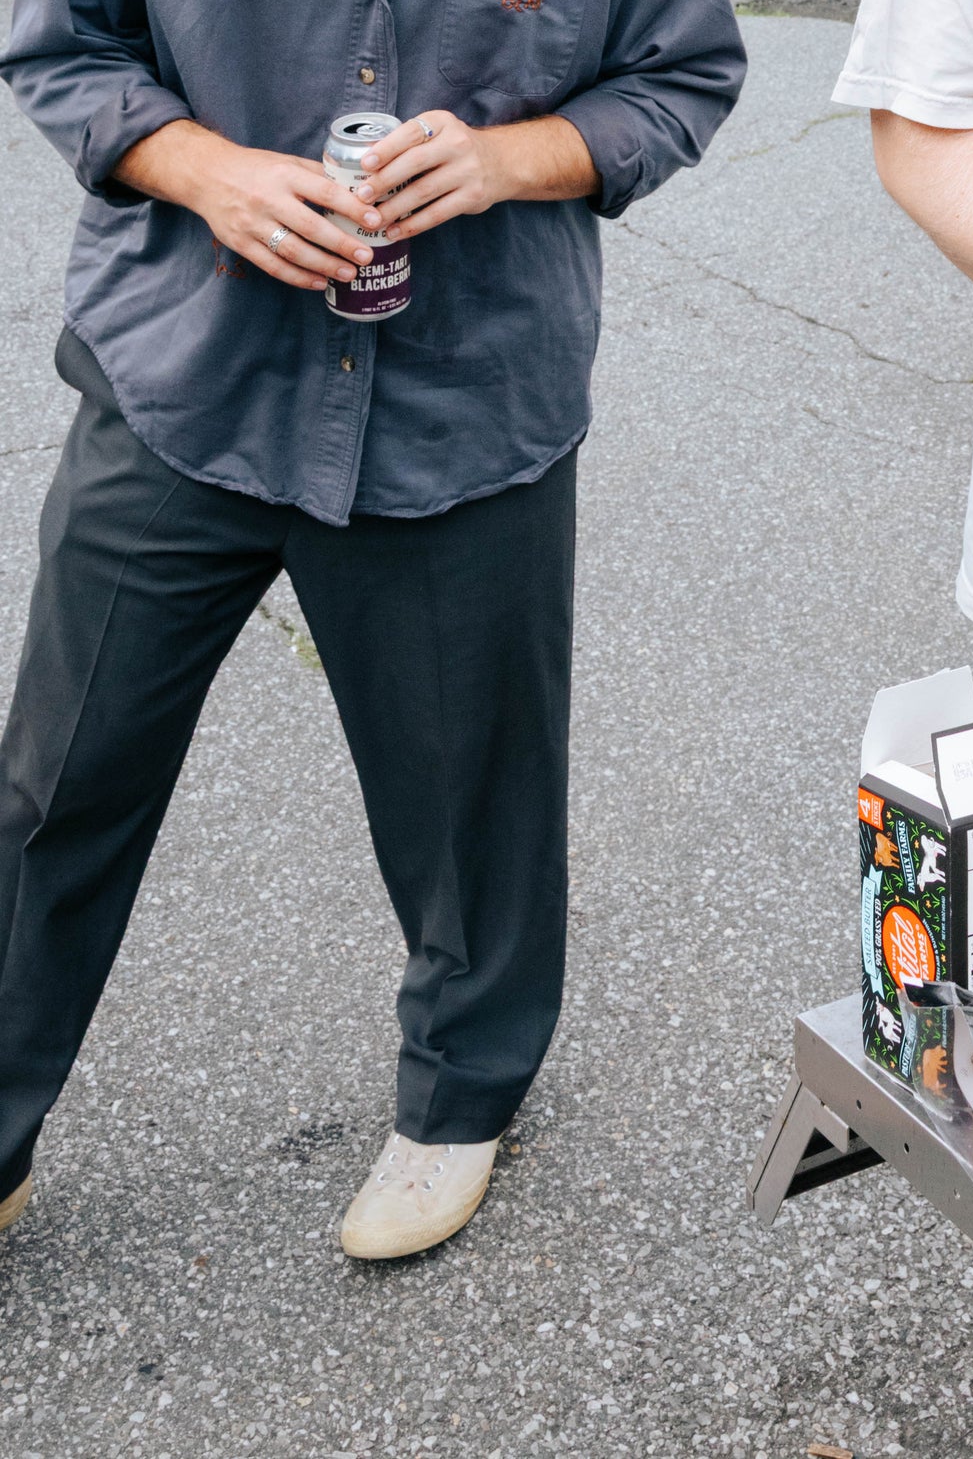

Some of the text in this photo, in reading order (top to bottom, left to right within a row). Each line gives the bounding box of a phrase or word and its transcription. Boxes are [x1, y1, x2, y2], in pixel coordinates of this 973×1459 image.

[350, 264, 411, 292] BLACKBERRY
[359, 254, 408, 277] SEMI-TART
[859, 794, 870, 819] 4
[898, 819, 915, 894] FAMILY FARMS
[865, 887, 873, 965] SALTED BUTTER
[889, 910, 923, 987] Vital
[917, 931, 928, 980] FARMS
